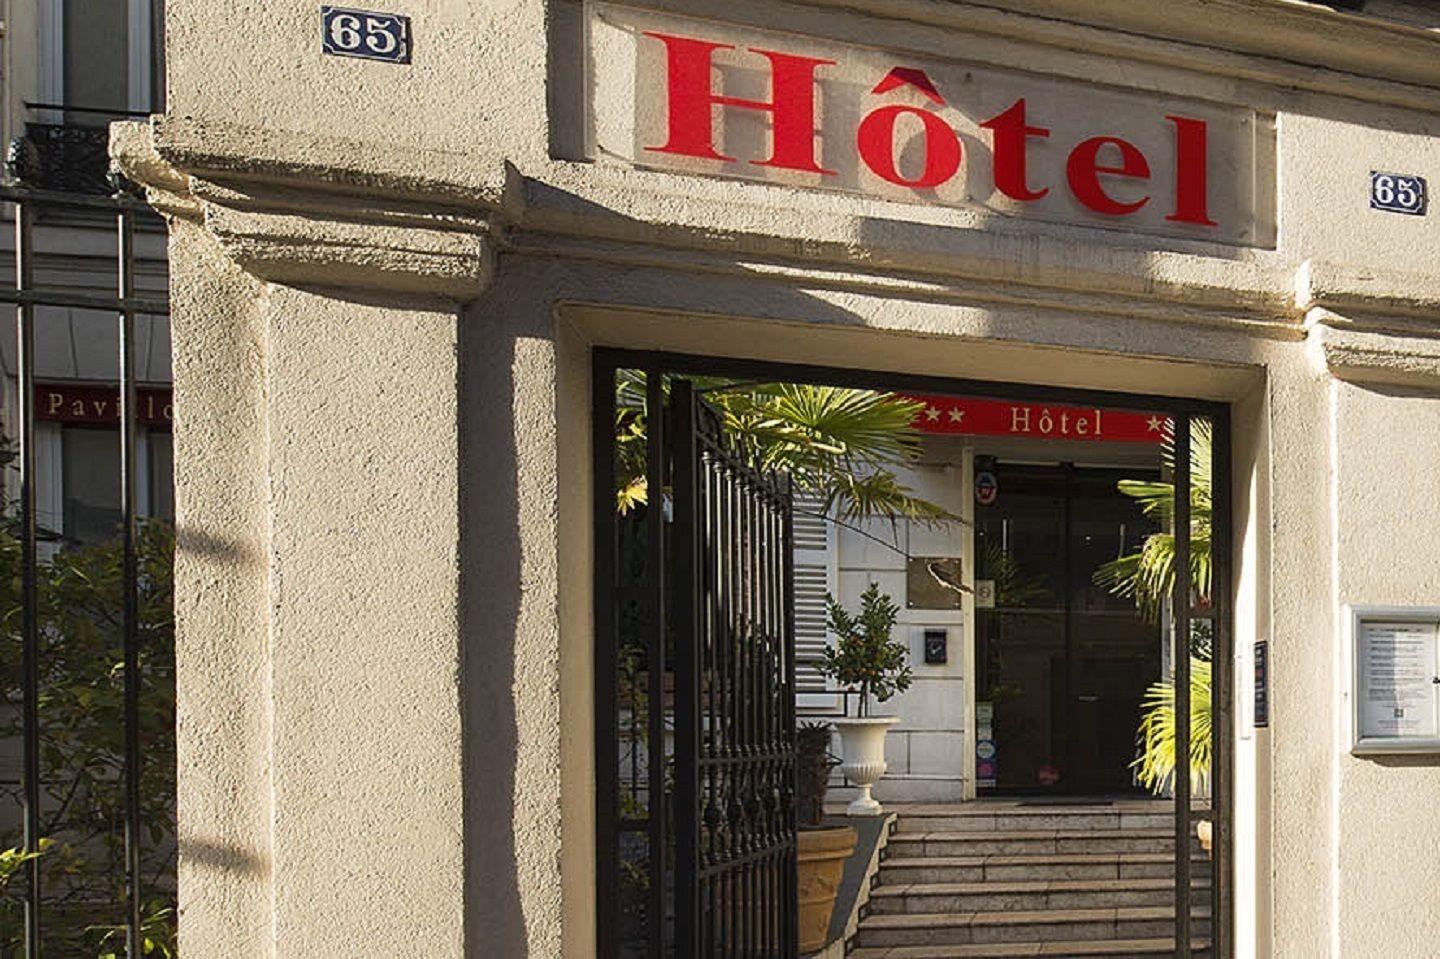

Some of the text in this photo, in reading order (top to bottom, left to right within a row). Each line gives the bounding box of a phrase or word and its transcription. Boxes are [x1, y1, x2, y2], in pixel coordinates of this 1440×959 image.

[330, 13, 397, 54] 65
[641, 30, 1219, 228] Hôtel
[1375, 175, 1418, 208] 65
[48, 392, 173, 420] Pavilo
[1010, 406, 1102, 436] Hôtel
